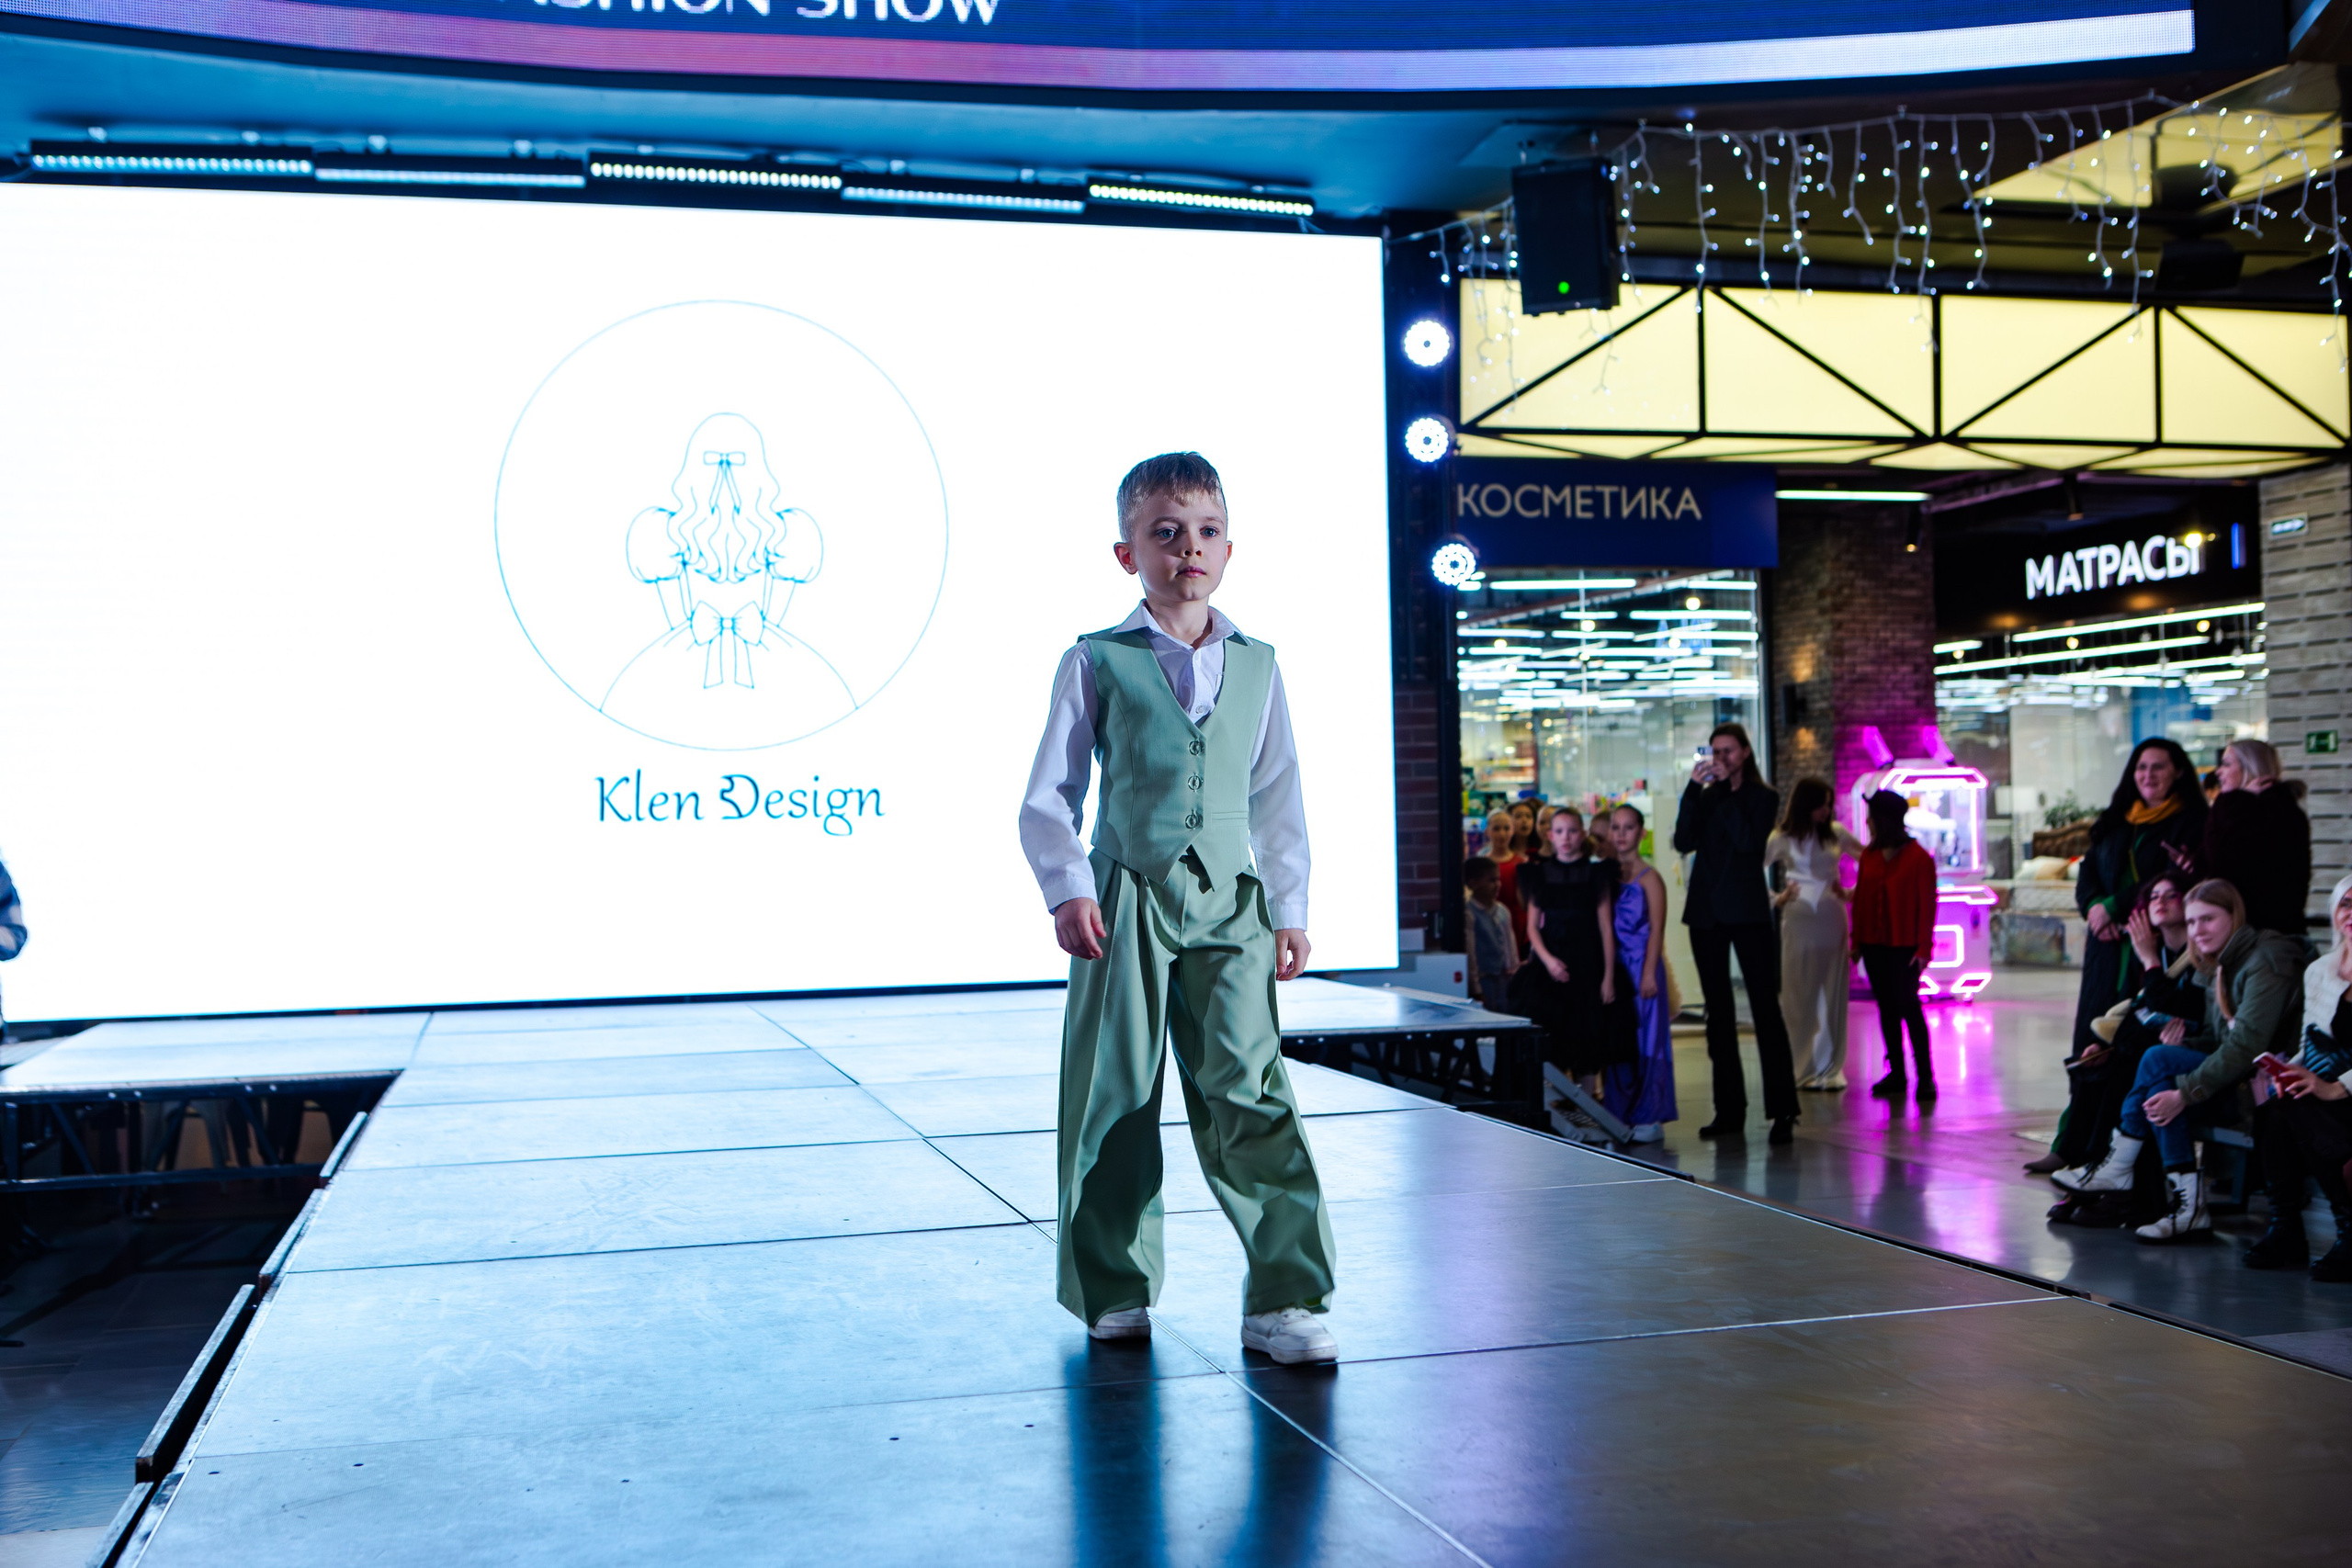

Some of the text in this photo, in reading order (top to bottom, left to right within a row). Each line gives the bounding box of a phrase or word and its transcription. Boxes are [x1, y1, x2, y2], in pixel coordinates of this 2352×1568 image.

[1456, 483, 1702, 521] КОСМЕТИКА
[594, 768, 887, 837] Klen Design
